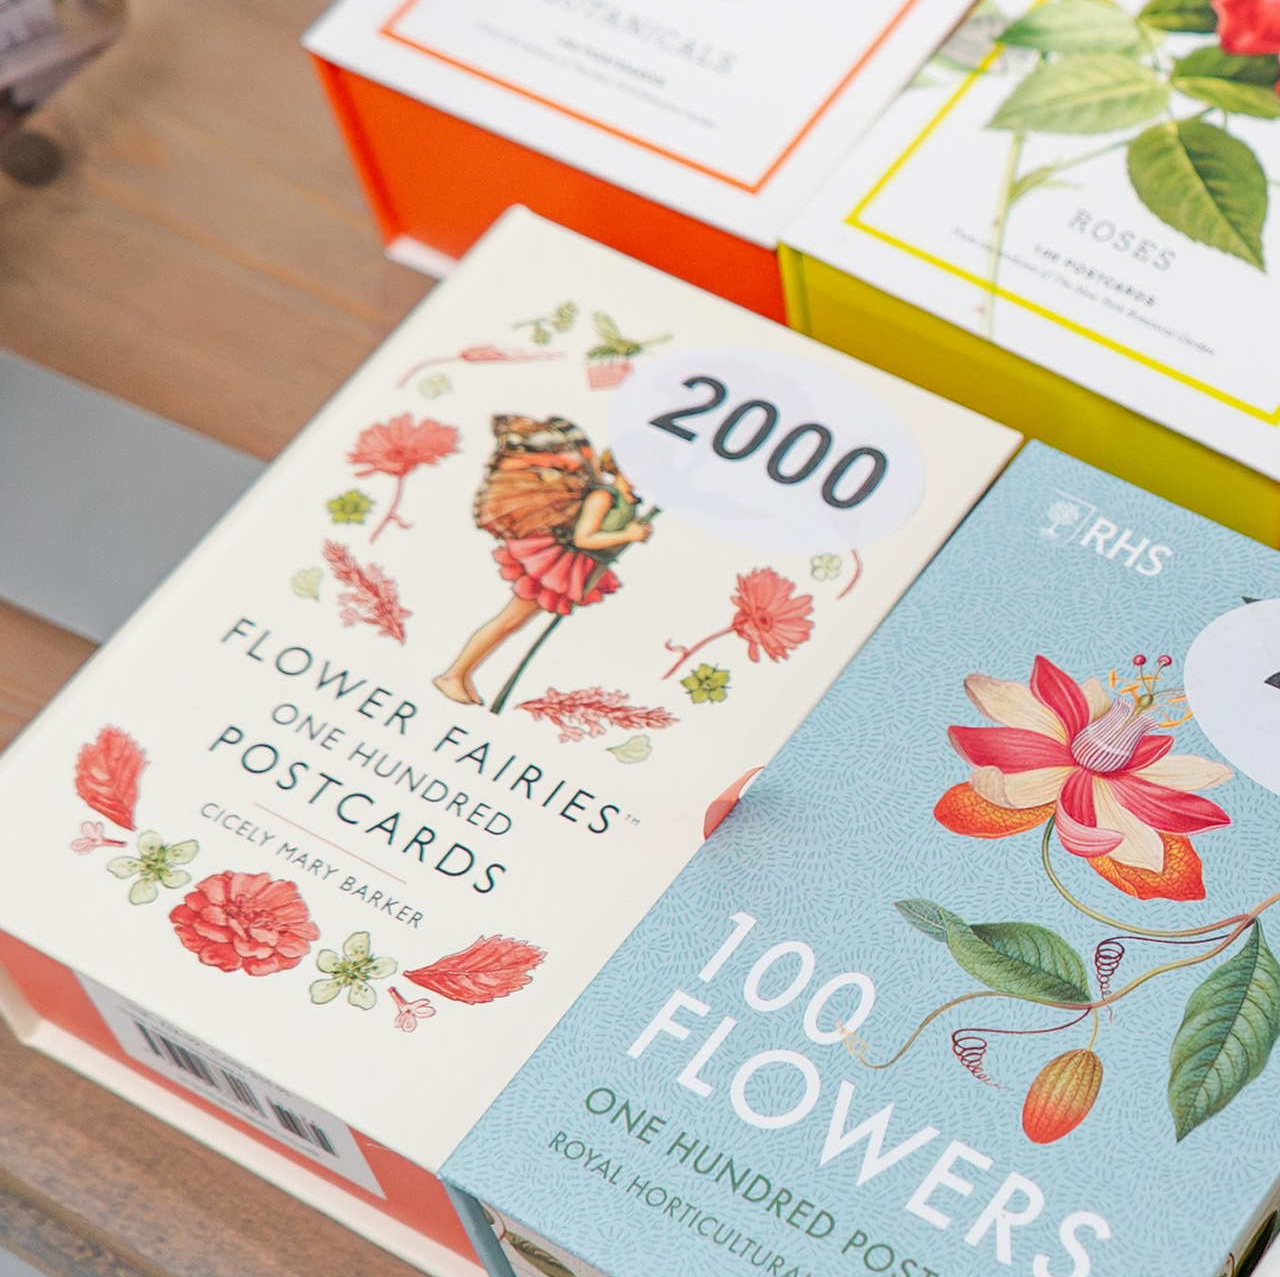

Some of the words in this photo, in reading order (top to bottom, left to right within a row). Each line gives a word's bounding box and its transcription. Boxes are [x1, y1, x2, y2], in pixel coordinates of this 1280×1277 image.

[1064, 257, 1156, 308] POSTCARDS
[1067, 208, 1177, 271] ROSES
[649, 374, 888, 510] 2000
[1080, 517, 1174, 578] RHS
[220, 617, 418, 736] FLOWER
[208, 724, 507, 895] POSTCARDS
[272, 702, 342, 750] ONE
[347, 740, 512, 836] HUNDRED
[201, 801, 276, 850] CICELY
[276, 839, 339, 884] MARY
[338, 874, 424, 929] BARKER
[698, 911, 875, 1044] 100
[548, 1132, 620, 1185] ROYAL
[584, 1088, 666, 1145] ONE
[666, 1132, 840, 1239] HUNDRED
